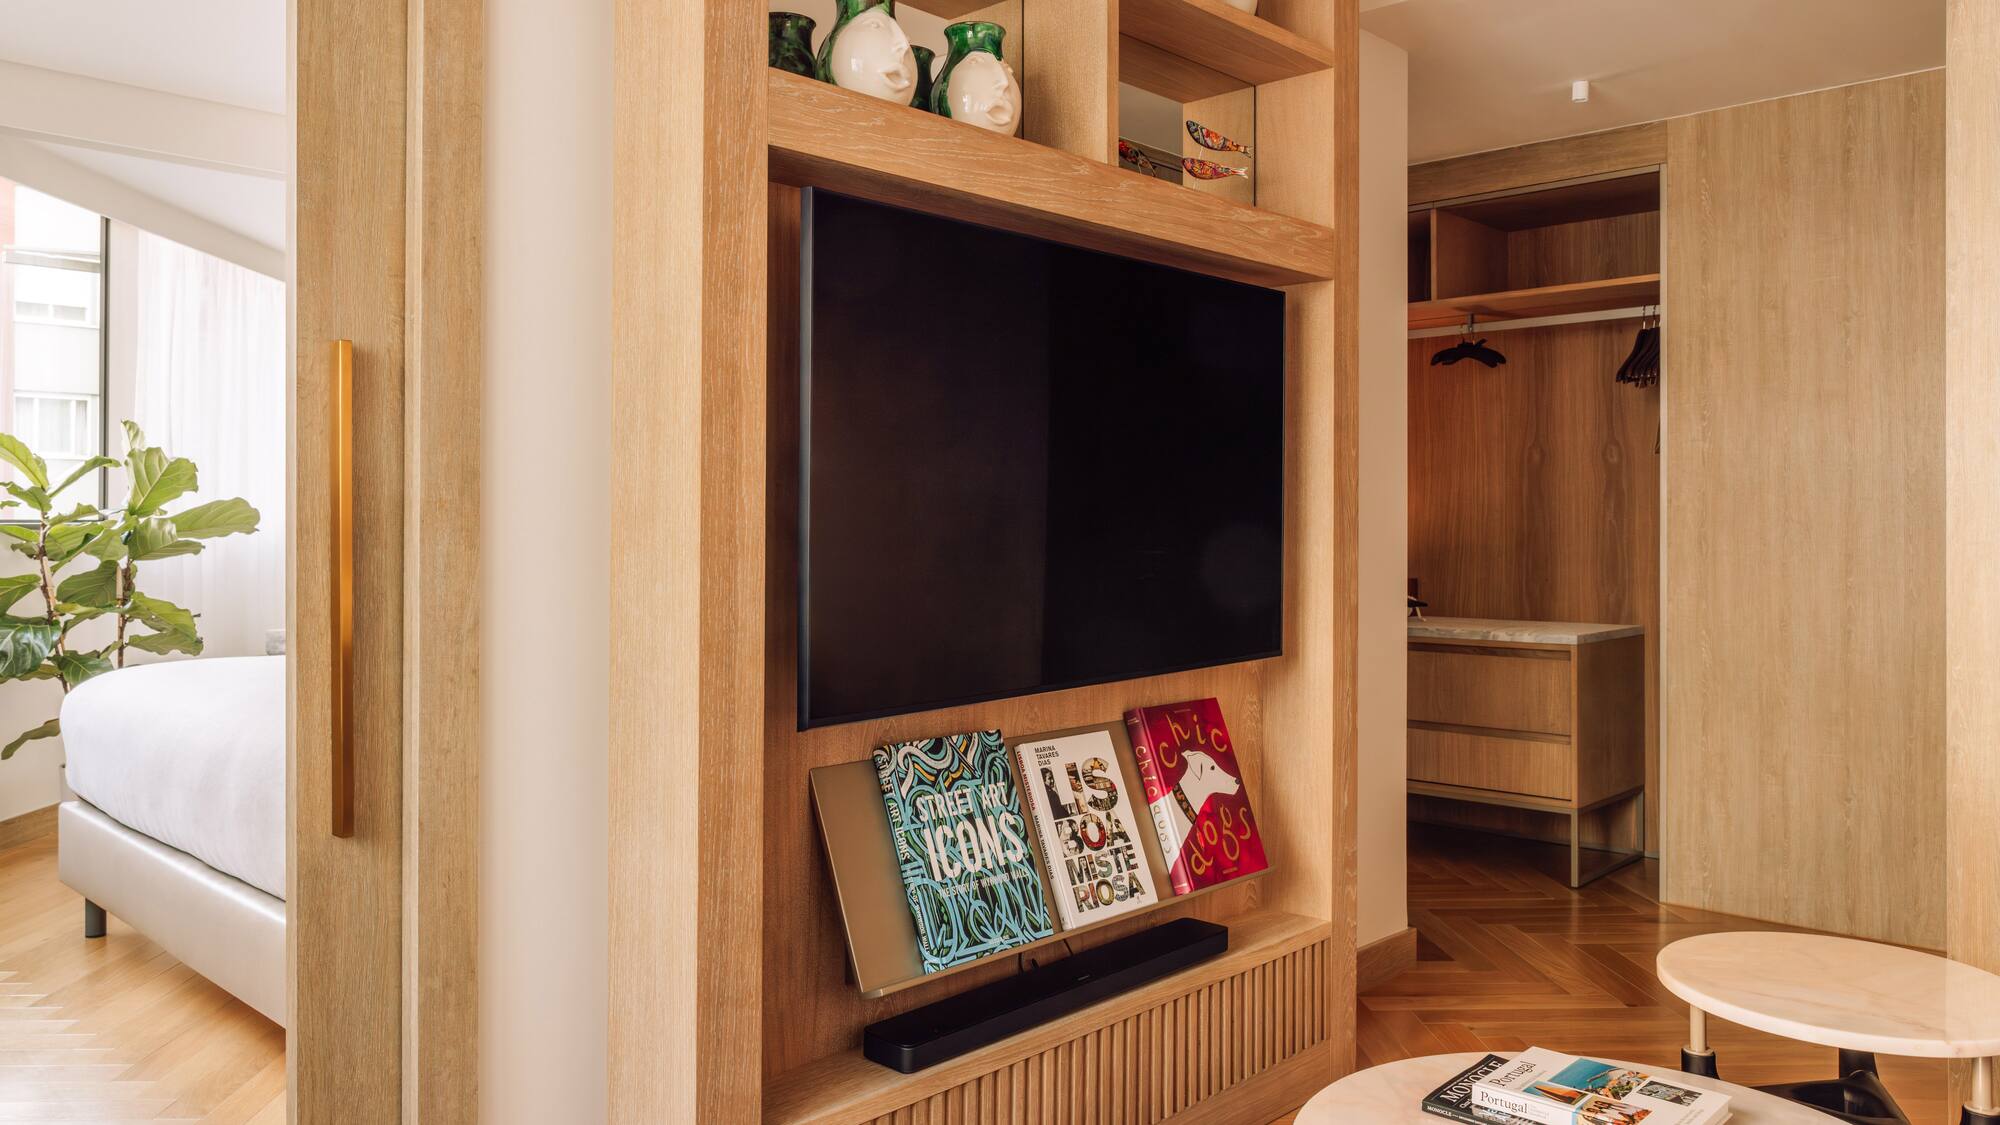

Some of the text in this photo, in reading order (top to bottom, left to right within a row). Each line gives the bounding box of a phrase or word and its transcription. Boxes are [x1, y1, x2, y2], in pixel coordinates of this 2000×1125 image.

[1035, 745, 1056, 754] MARINA
[1036, 751, 1059, 761] TAVARES
[878, 756, 911, 860] STREET ART ICONS
[916, 781, 1008, 822] STREET ART
[1017, 751, 1025, 771] LISBOA
[1023, 772, 1035, 811] MISTERIOSA
[1034, 815, 1044, 839] MARINA
[1040, 839, 1051, 865] TAVARES
[1040, 757, 1118, 820] LIS
[924, 812, 1024, 881] ICONS
[1054, 812, 1131, 858] BOA
[1190, 803, 1251, 875] dogs
[1072, 871, 1146, 913] RIOSA
[1489, 1060, 1536, 1087] Portugal
[1427, 1105, 1452, 1117] MONOCLE
[1480, 1091, 1528, 1114] Portugal
